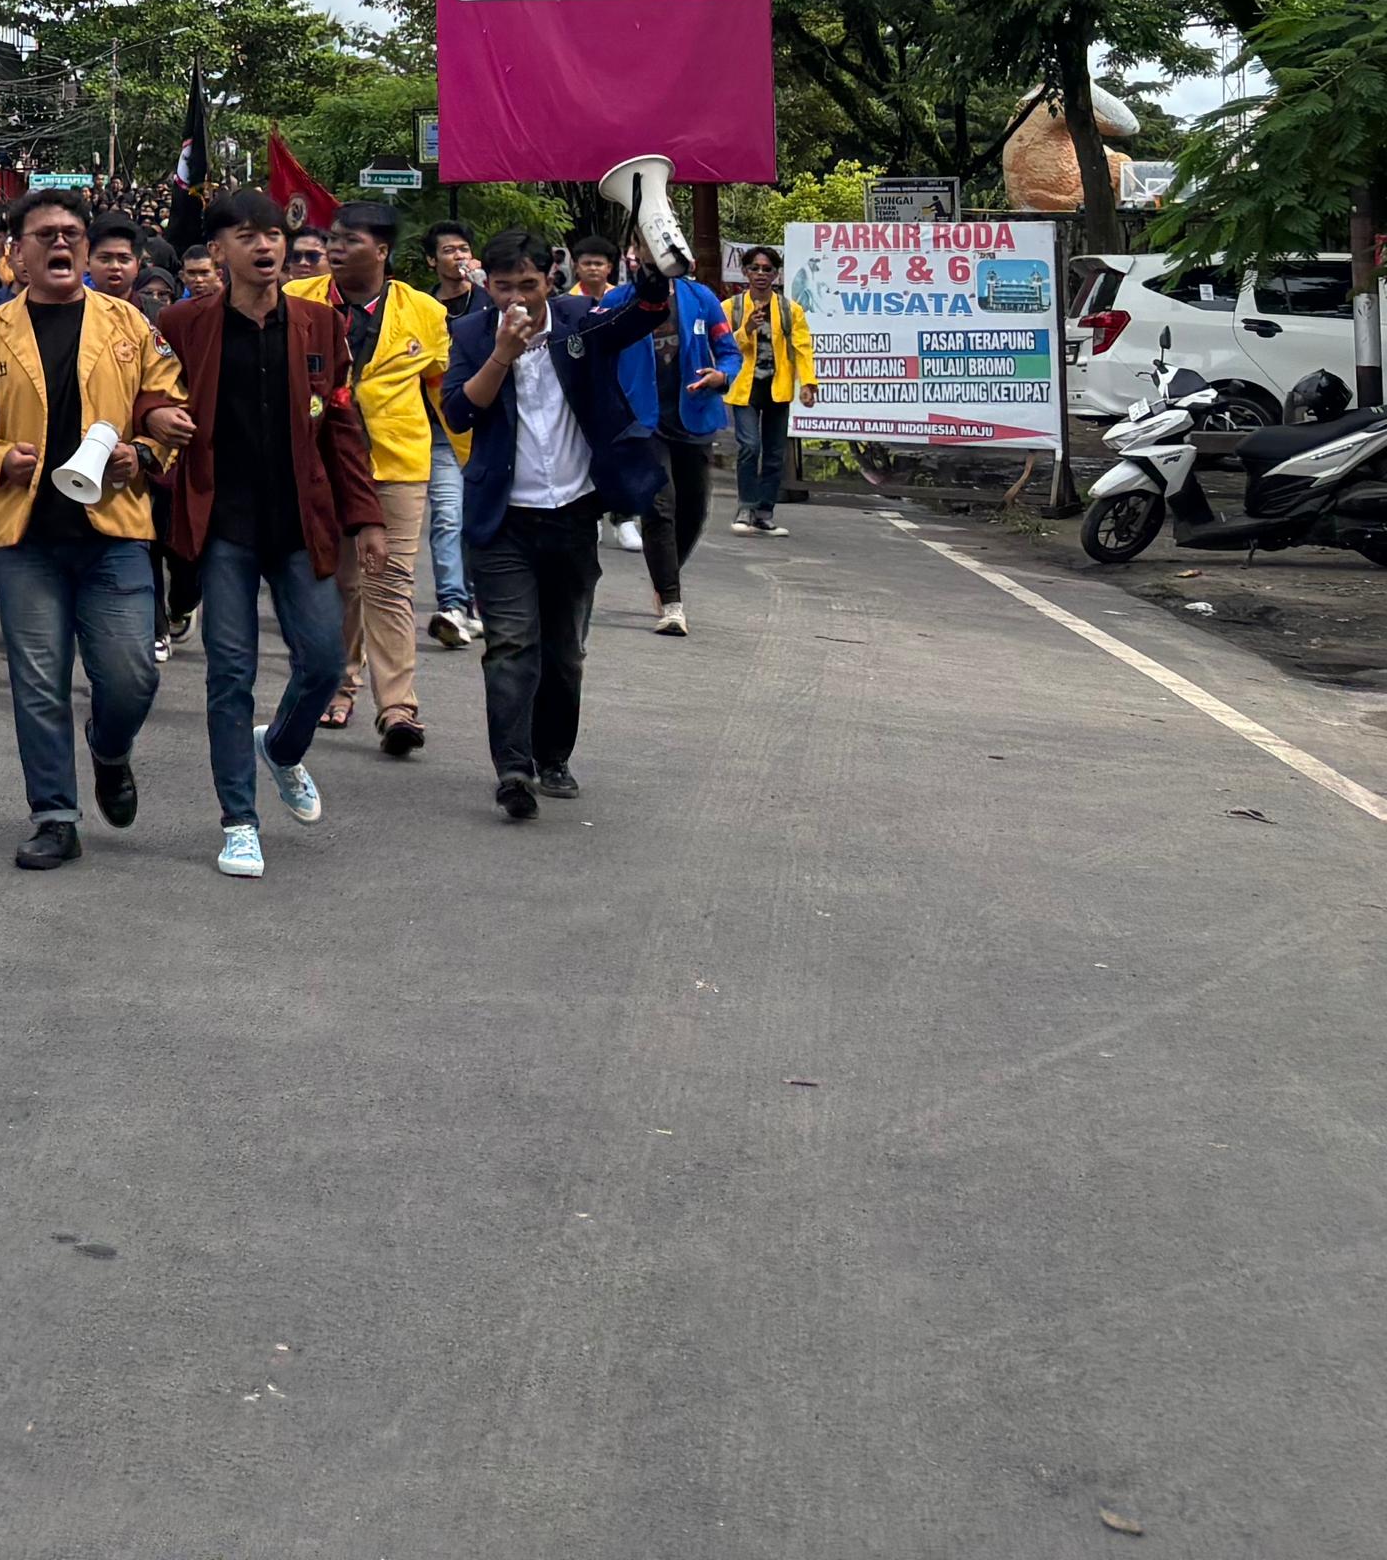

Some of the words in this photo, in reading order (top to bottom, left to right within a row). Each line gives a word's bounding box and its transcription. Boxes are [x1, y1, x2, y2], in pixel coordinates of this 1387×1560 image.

[874, 196, 914, 205] SUNGAI
[814, 223, 921, 251] PARKIR
[933, 223, 1016, 251] RODA
[837, 256, 892, 287] 2,4
[906, 256, 933, 284] &
[948, 256, 971, 284] 6
[840, 292, 973, 316] WISATA
[810, 333, 842, 354] USUR
[843, 332, 890, 353] SUNGAI
[922, 331, 965, 351] PASAR
[968, 330, 1035, 351] TERAPUNG
[815, 357, 841, 378] LAU
[843, 357, 906, 377] KAMBANG
[922, 357, 965, 378] PULAU
[968, 356, 1016, 377] BROMO
[815, 383, 849, 403] TUNG
[851, 383, 918, 403] BEKANTAN
[922, 382, 987, 403] KAMPUNG
[990, 382, 1050, 403] KETUPAT
[796, 418, 861, 432] NUSANTARA
[864, 419, 894, 433] BARU
[897, 420, 957, 436] INDONESIA
[959, 424, 994, 438] MAJU
